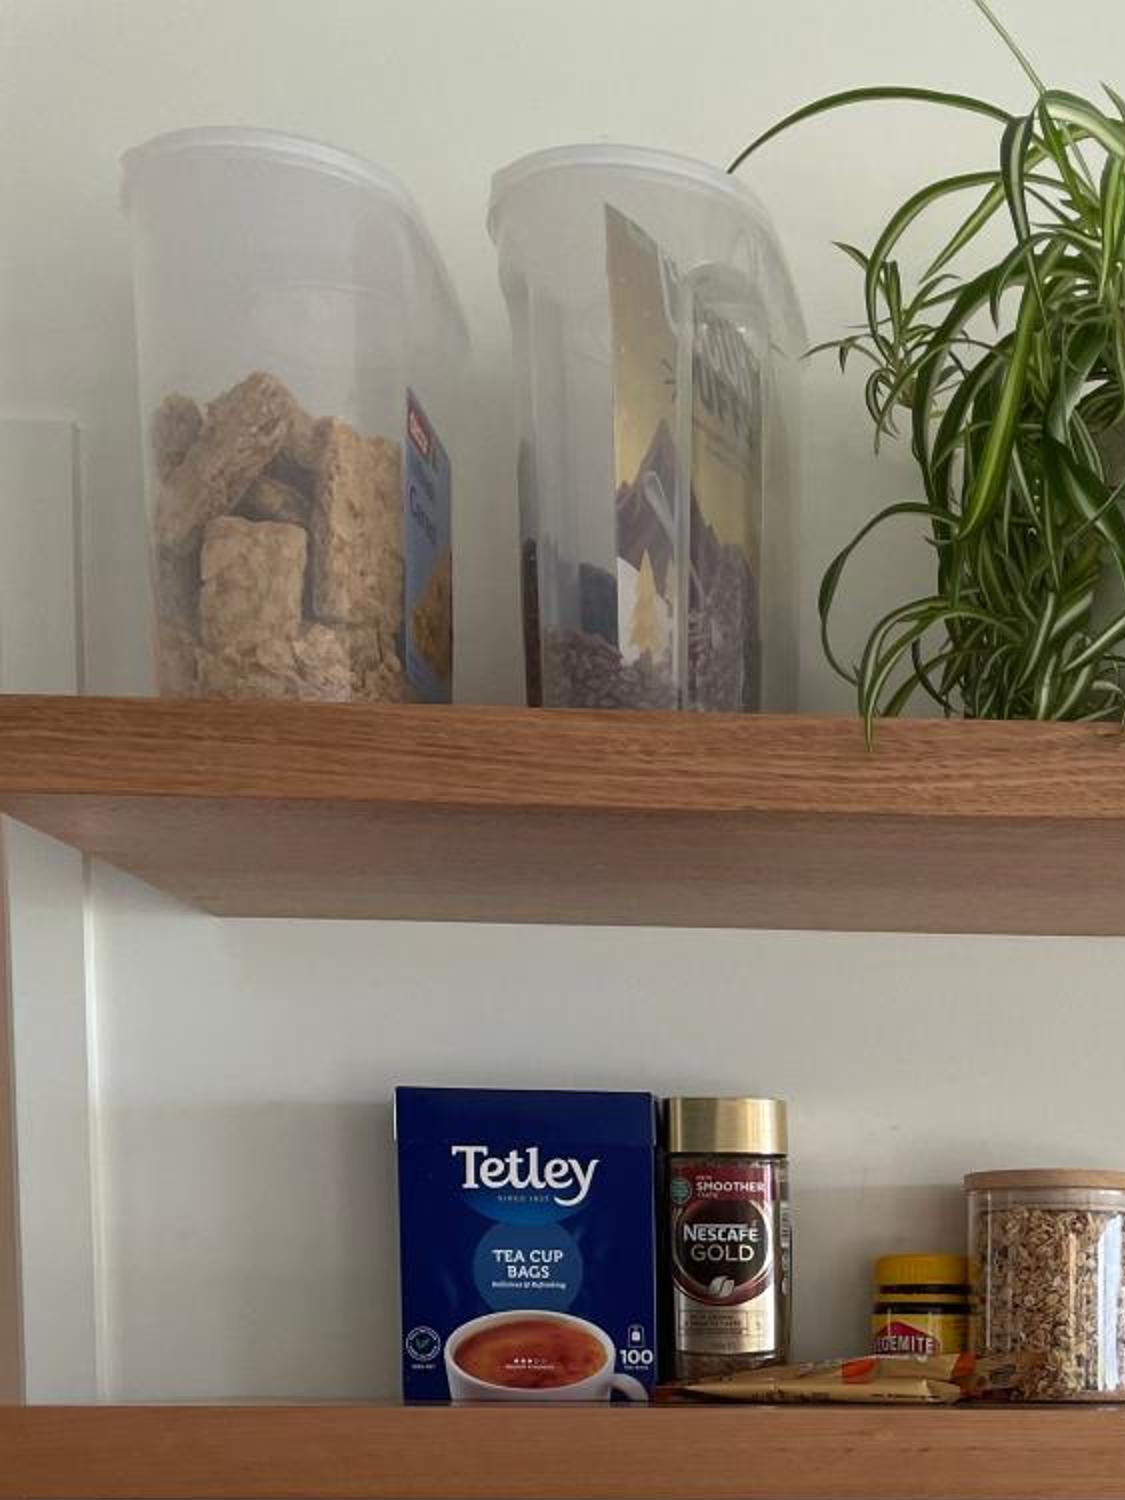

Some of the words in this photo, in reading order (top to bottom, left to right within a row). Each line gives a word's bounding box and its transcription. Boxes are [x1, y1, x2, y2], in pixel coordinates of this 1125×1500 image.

[451, 1145, 600, 1207] Tetley
[695, 1181, 768, 1192] SMOOTHER
[492, 1249, 526, 1263] TEA
[529, 1249, 564, 1263] CUP
[690, 1243, 755, 1262] GOLD
[507, 1265, 551, 1279] BAGS
[619, 1349, 654, 1365] 100
